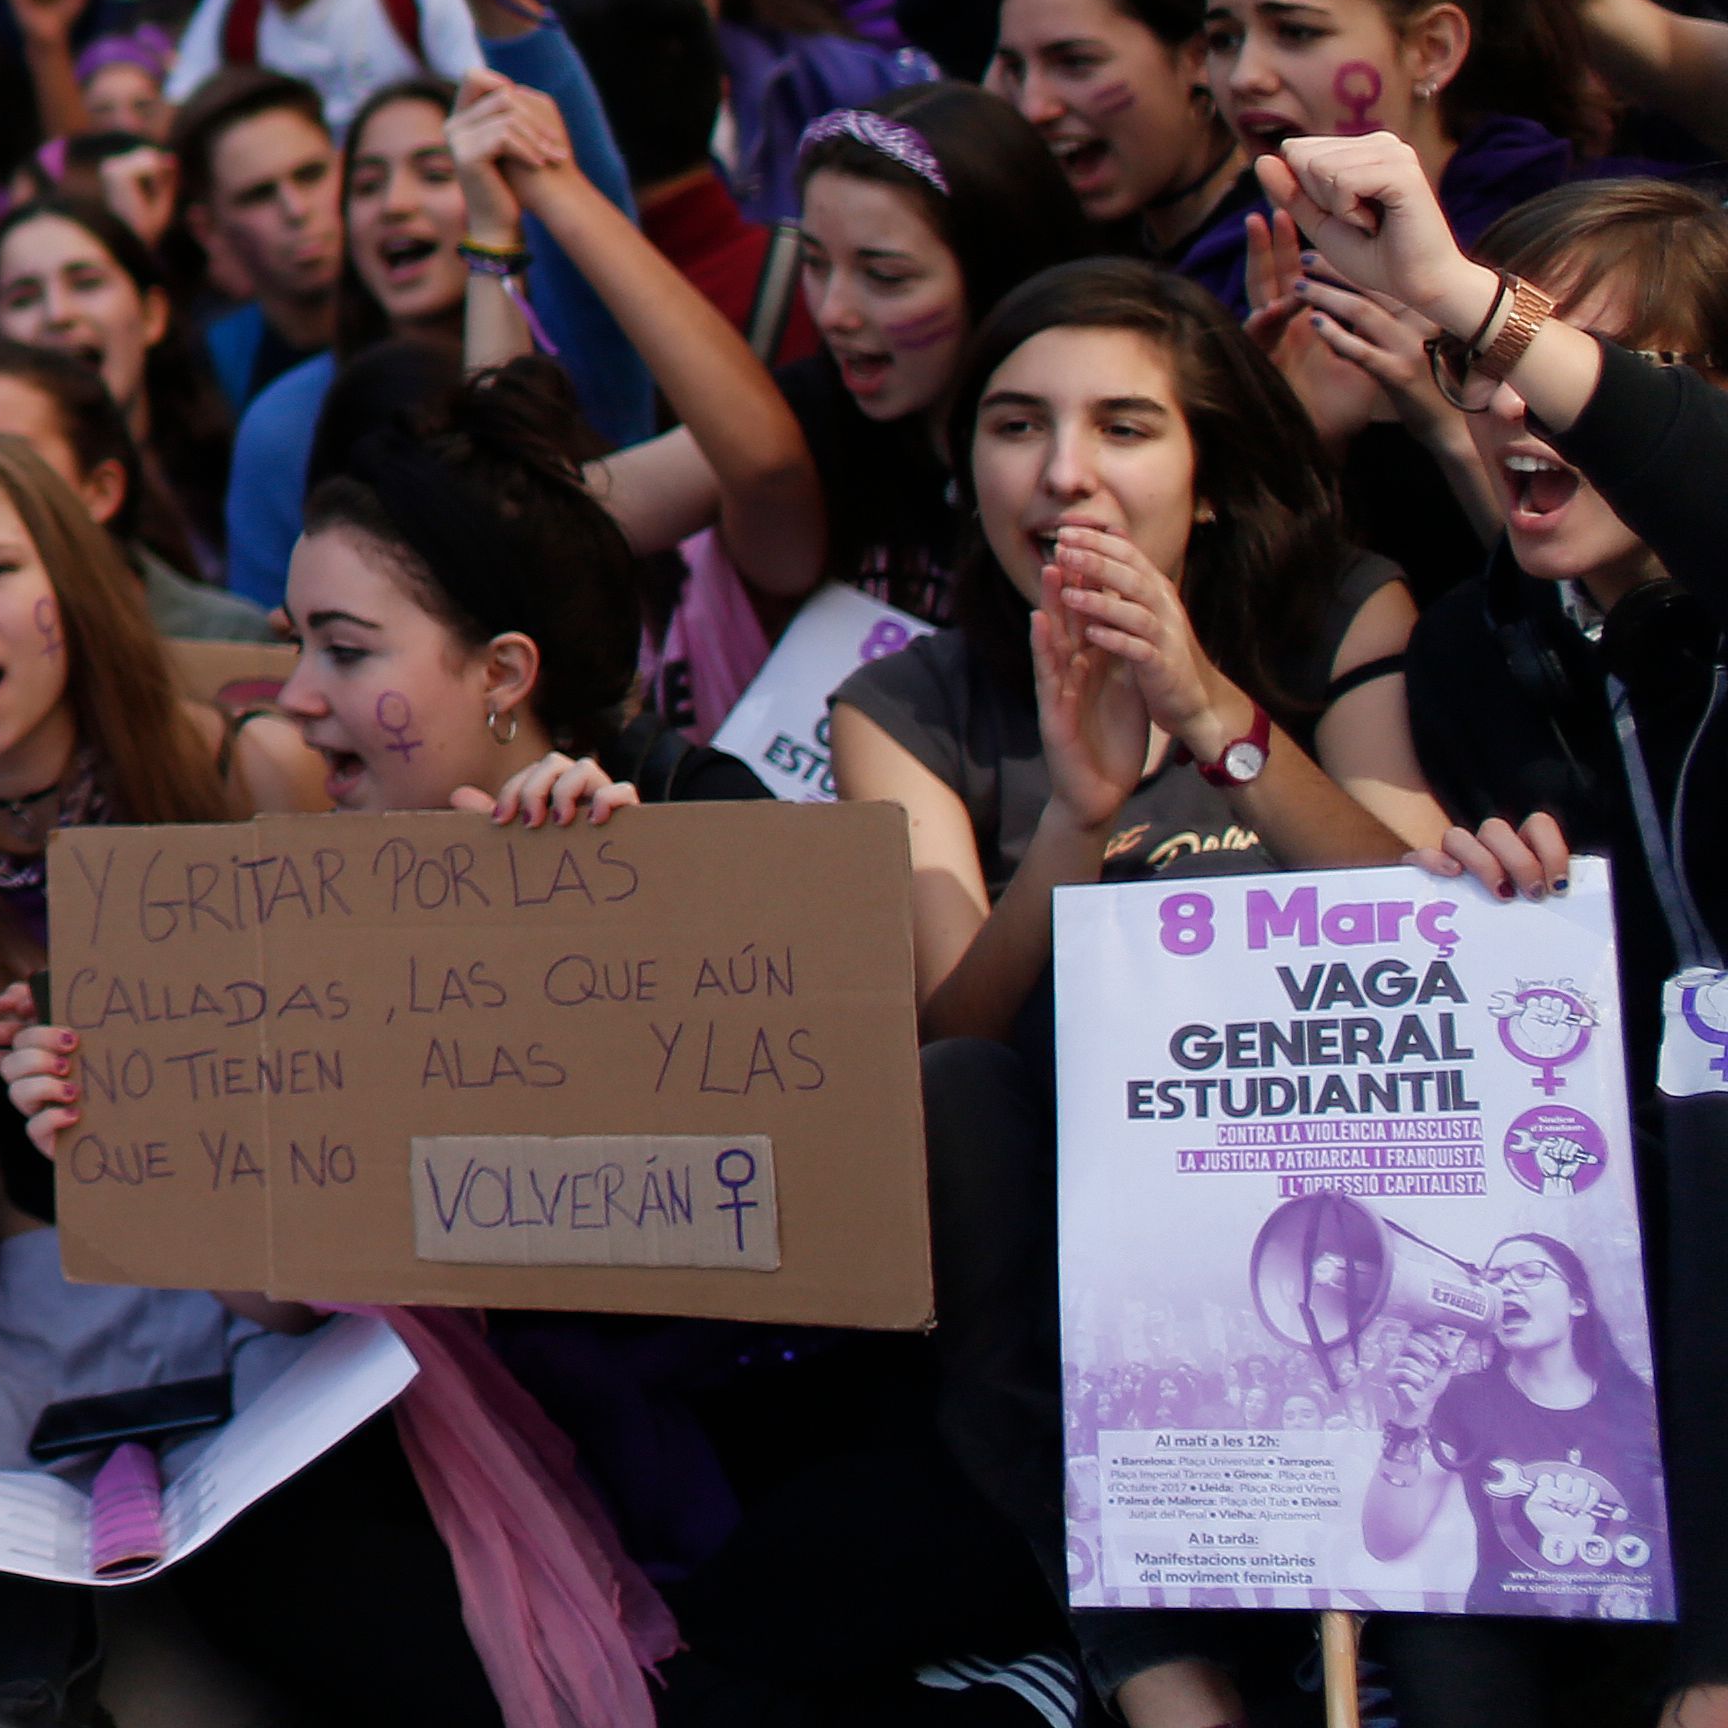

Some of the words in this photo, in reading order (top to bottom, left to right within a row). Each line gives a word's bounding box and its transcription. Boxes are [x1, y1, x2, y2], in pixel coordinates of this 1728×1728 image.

[72, 846, 116, 946] Y
[372, 836, 491, 914] POR
[506, 840, 641, 910] LAS
[1158, 891, 1216, 957] 8
[1245, 885, 1462, 960] Març
[64, 968, 351, 1030] CALLADAS
[544, 953, 659, 1007] QUE
[693, 943, 796, 999] AÚN
[1274, 958, 1470, 1012] VAGA
[1168, 1011, 1476, 1072] GENERAL
[78, 1048, 154, 1104] NO
[164, 1046, 345, 1102] TIENEN
[422, 1038, 568, 1090] ALAS
[649, 1022, 683, 1094] Y
[699, 1021, 827, 1096] LAS
[1126, 1069, 1481, 1121] ESTUDIANTIL
[1217, 1124, 1277, 1145] CONTRA
[1281, 1123, 1302, 1144] LA
[1393, 1118, 1484, 1141] MASCLISTA
[69, 1133, 176, 1186] QUE
[197, 1130, 267, 1191] YA
[289, 1134, 358, 1188] NO
[1176, 1151, 1197, 1172] LA
[1276, 1147, 1371, 1170] PATRIARCAL
[1374, 1148, 1382, 1168] I
[1386, 1145, 1486, 1169] FRANQUISTA
[423, 1154, 695, 1235] VOLVERÁN
[1278, 1177, 1285, 1196] I
[1385, 1173, 1488, 1195] CAPITALISTA
[1155, 1435, 1171, 1447] Al
[1174, 1434, 1208, 1447] matí
[1211, 1438, 1219, 1447] a
[1223, 1435, 1244, 1448] les
[1248, 1435, 1280, 1448] 12h:
[1121, 1457, 1176, 1467] Barcelona:
[1279, 1458, 1335, 1469] Tarragona:
[1233, 1471, 1273, 1481] Girona:
[1117, 1497, 1151, 1507] Palma
[1153, 1497, 1166, 1507] de
[1168, 1497, 1218, 1507] Mallorca:
[1188, 1533, 1201, 1545] A
[1203, 1533, 1215, 1545] la
[1219, 1533, 1260, 1546] tarda:
[1135, 1552, 1247, 1566] Manifestacions
[1251, 1552, 1317, 1567] unitàries
[1139, 1571, 1162, 1584] del
[1165, 1571, 1240, 1584] moviment
[1244, 1571, 1314, 1585] feminista
